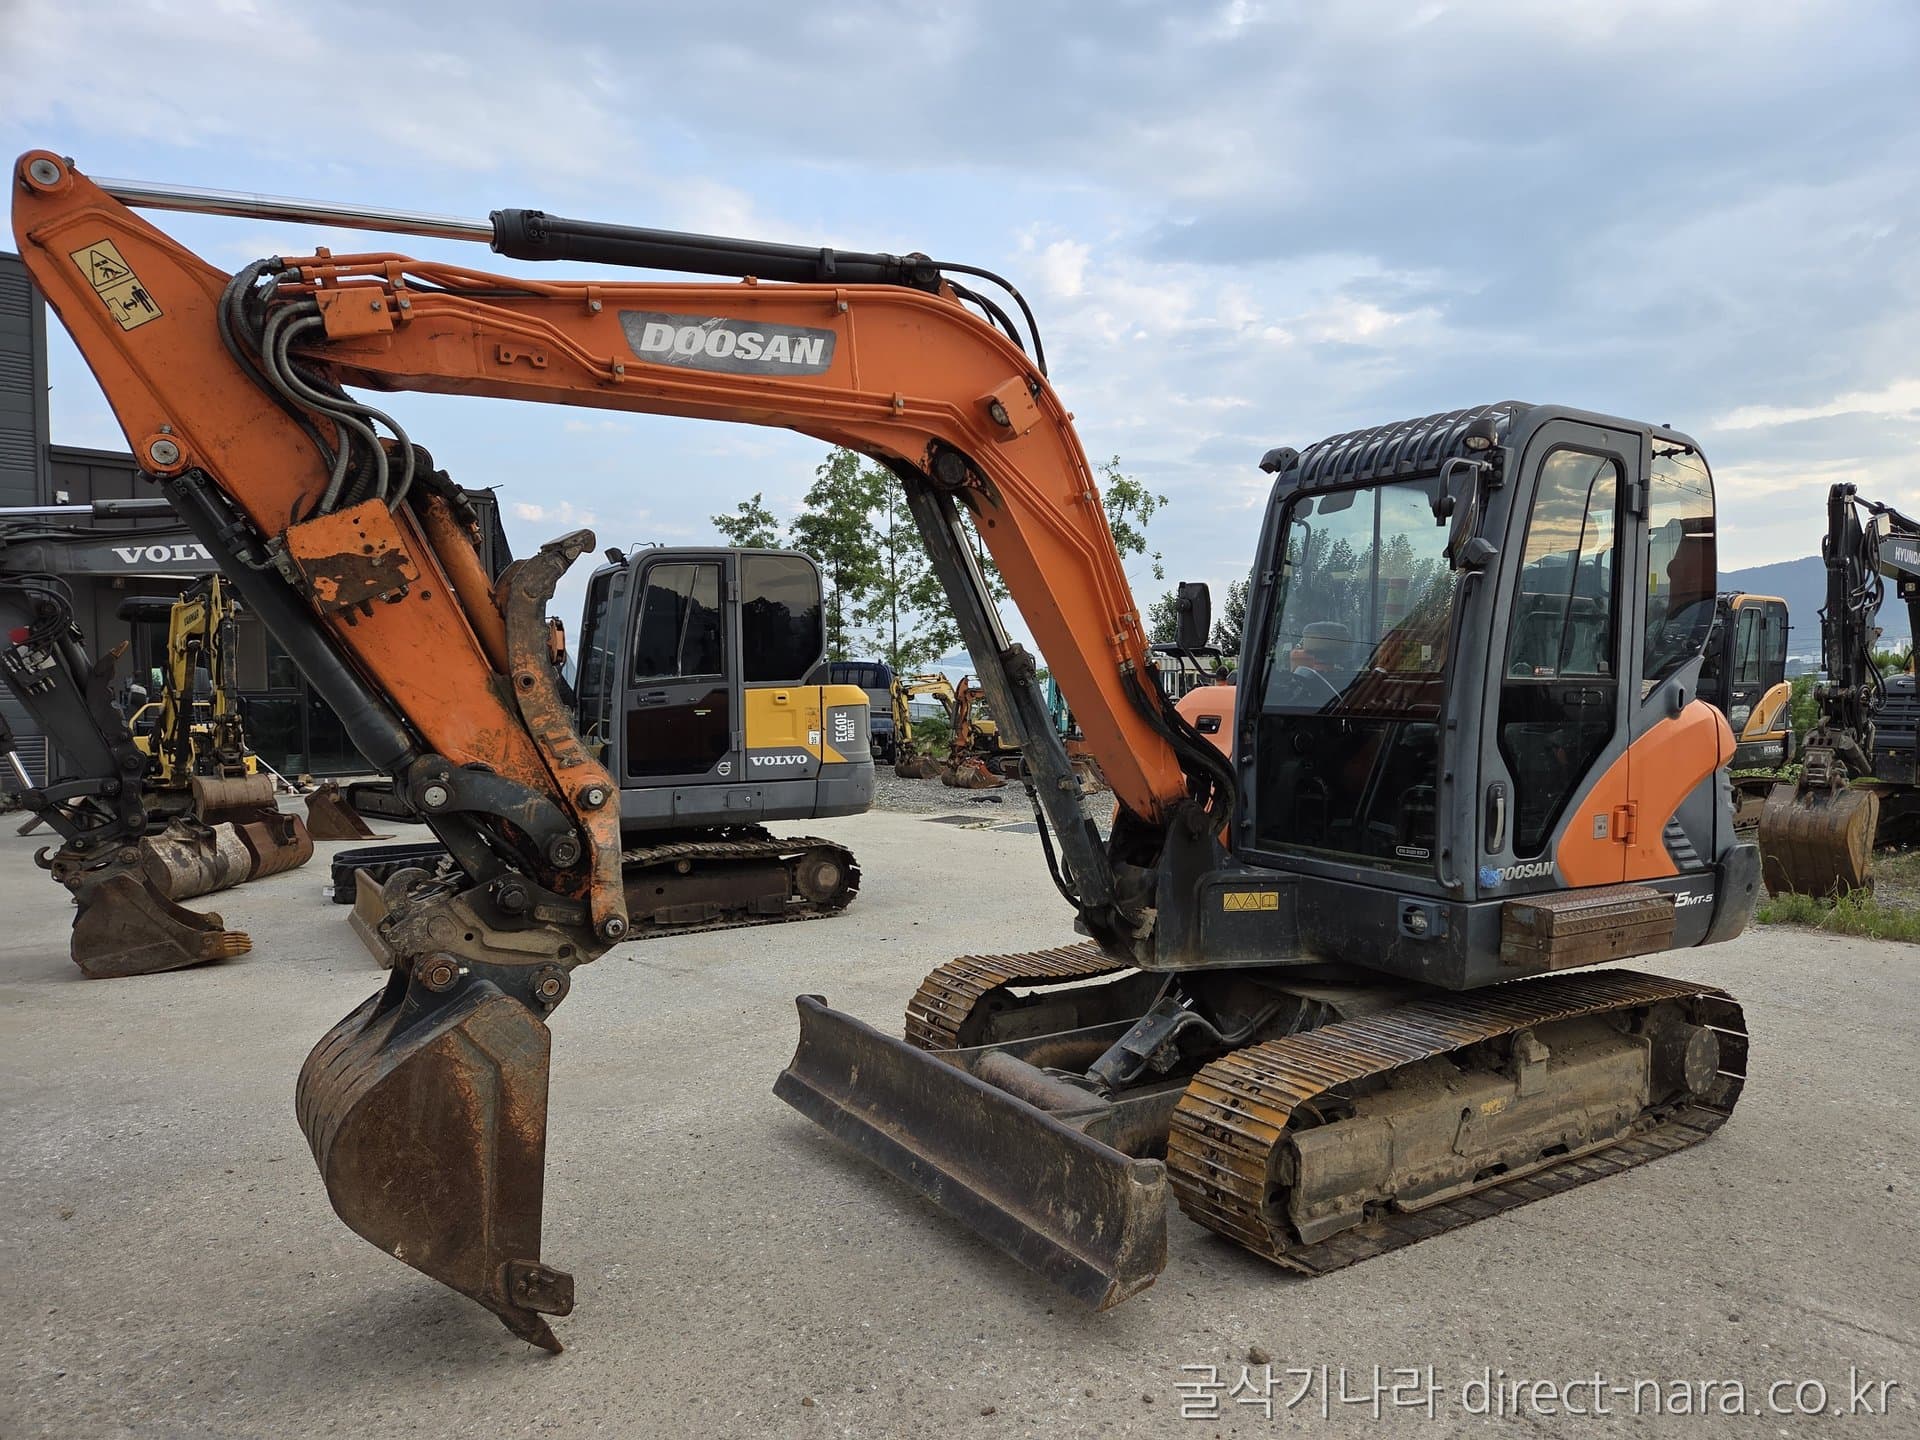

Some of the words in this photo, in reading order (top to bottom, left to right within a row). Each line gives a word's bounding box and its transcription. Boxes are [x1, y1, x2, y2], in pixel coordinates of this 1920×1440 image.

[639, 322, 825, 366] DOOSAN
[834, 711, 848, 743] EC60E
[847, 719, 856, 742] FOREST
[749, 754, 808, 766] VOLVO
[1497, 861, 1555, 881] DOOSAN
[1674, 891, 1714, 908] 5MT-5
